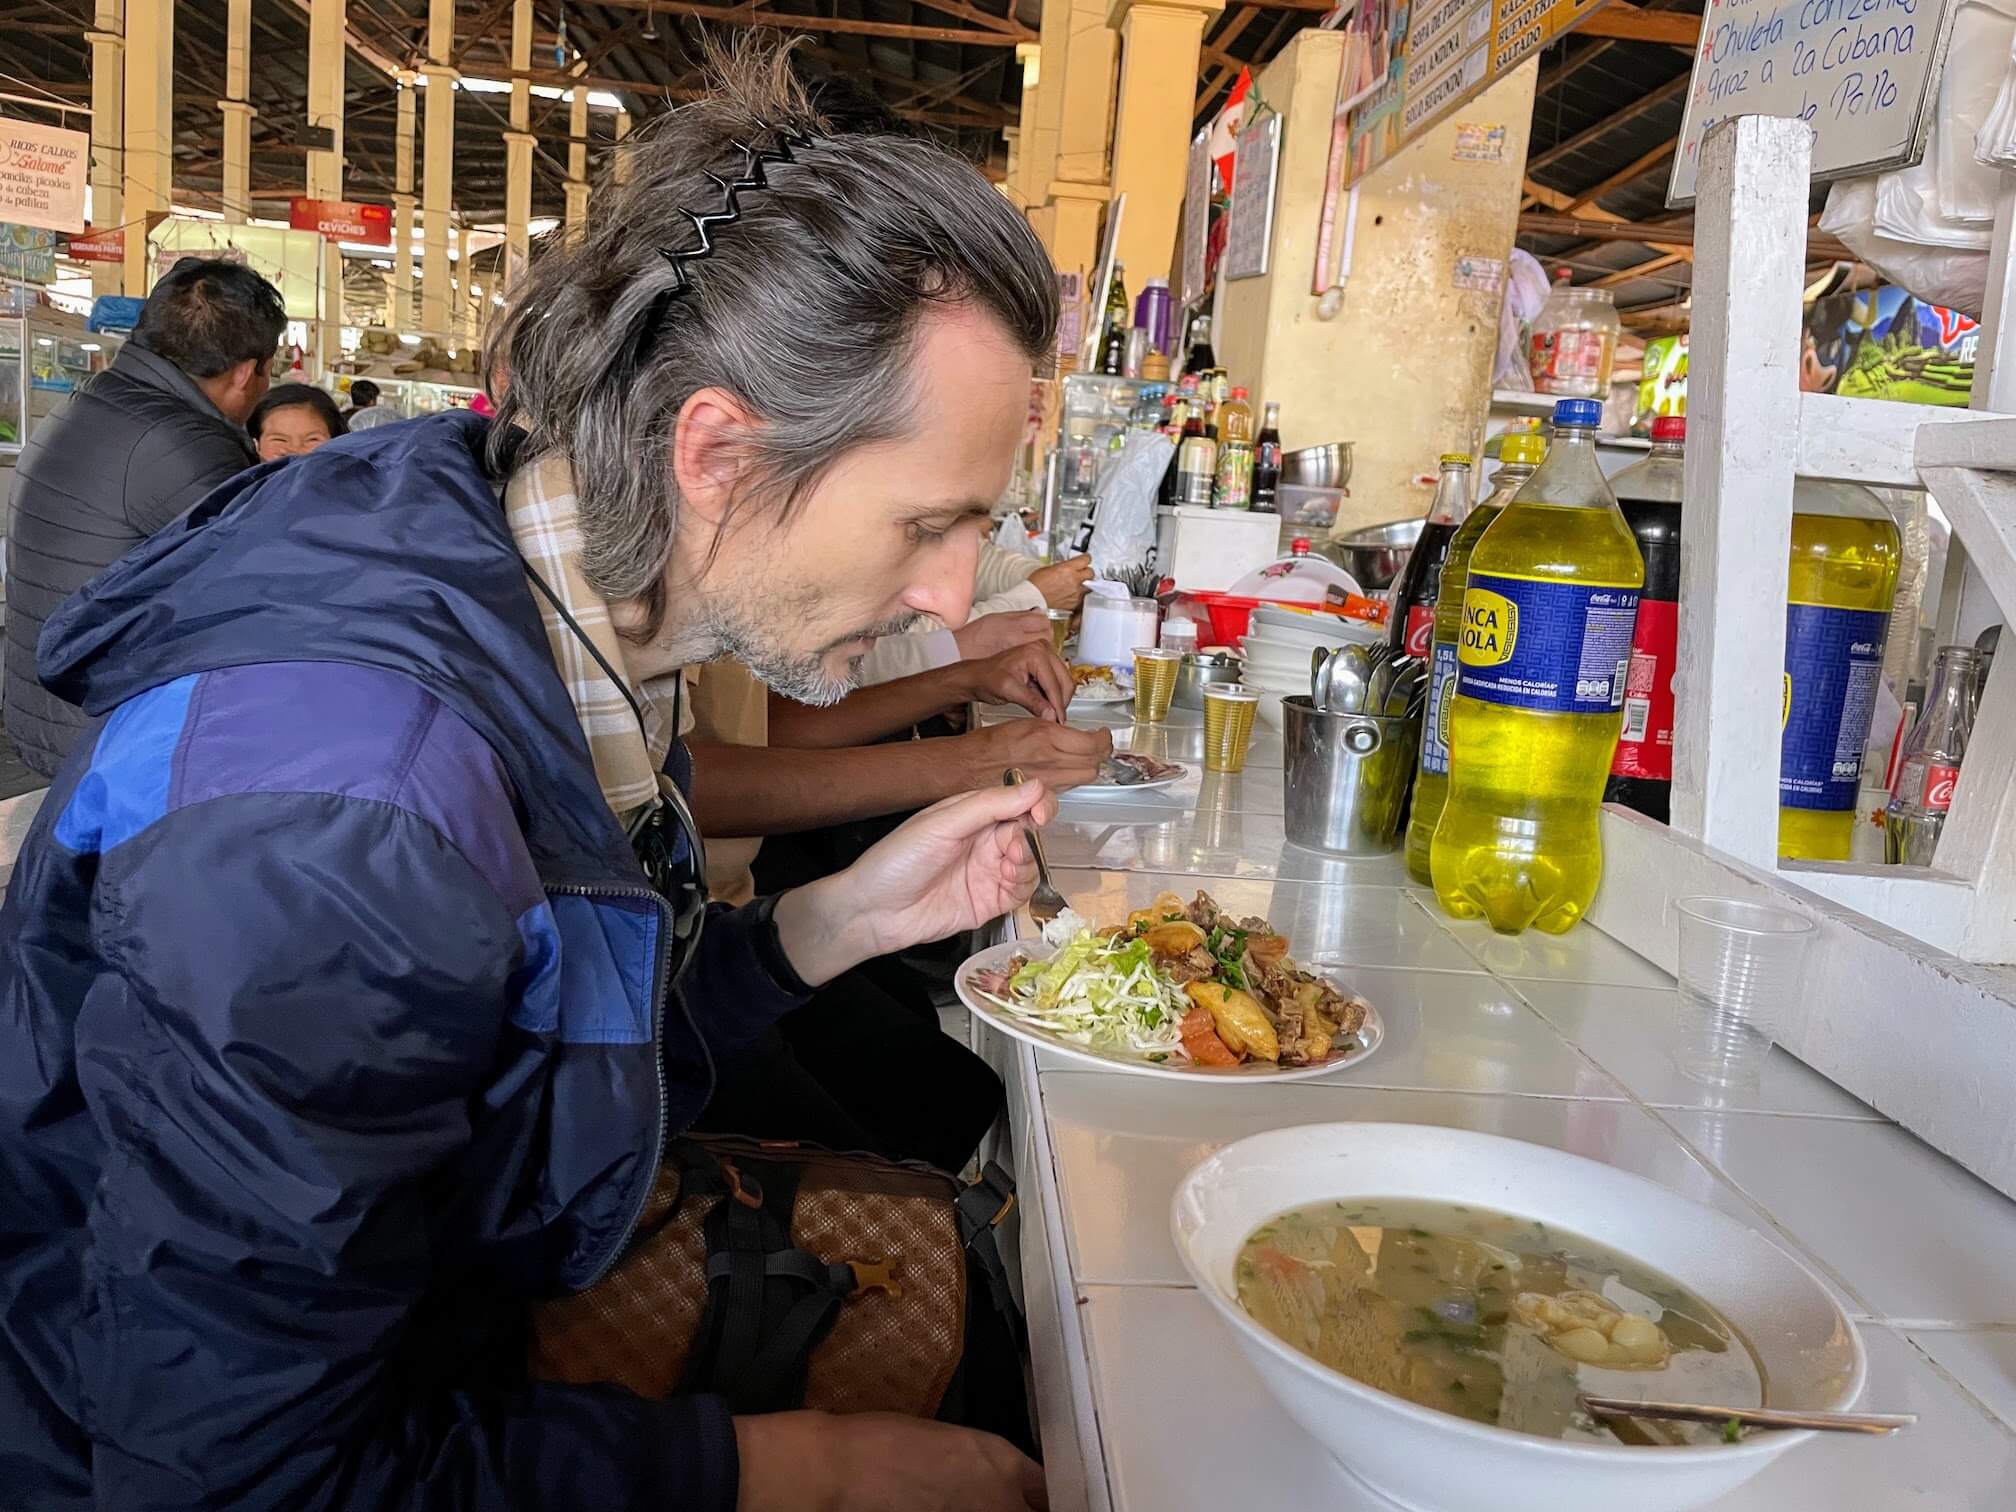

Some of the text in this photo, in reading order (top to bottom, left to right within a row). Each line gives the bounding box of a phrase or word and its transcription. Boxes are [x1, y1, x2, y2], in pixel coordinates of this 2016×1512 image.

[1498, 9, 1531, 46] HUEVO
[1495, 26, 1540, 71] SALTADO
[1823, 24, 1914, 70] Cubana
[1831, 69, 1897, 120] Pollo
[11, 139, 78, 159] RICOS CALDOS
[16, 185, 49, 198] cabeza
[318, 221, 366, 236] CEVICHES
[1499, 677, 1522, 686] MENOS
